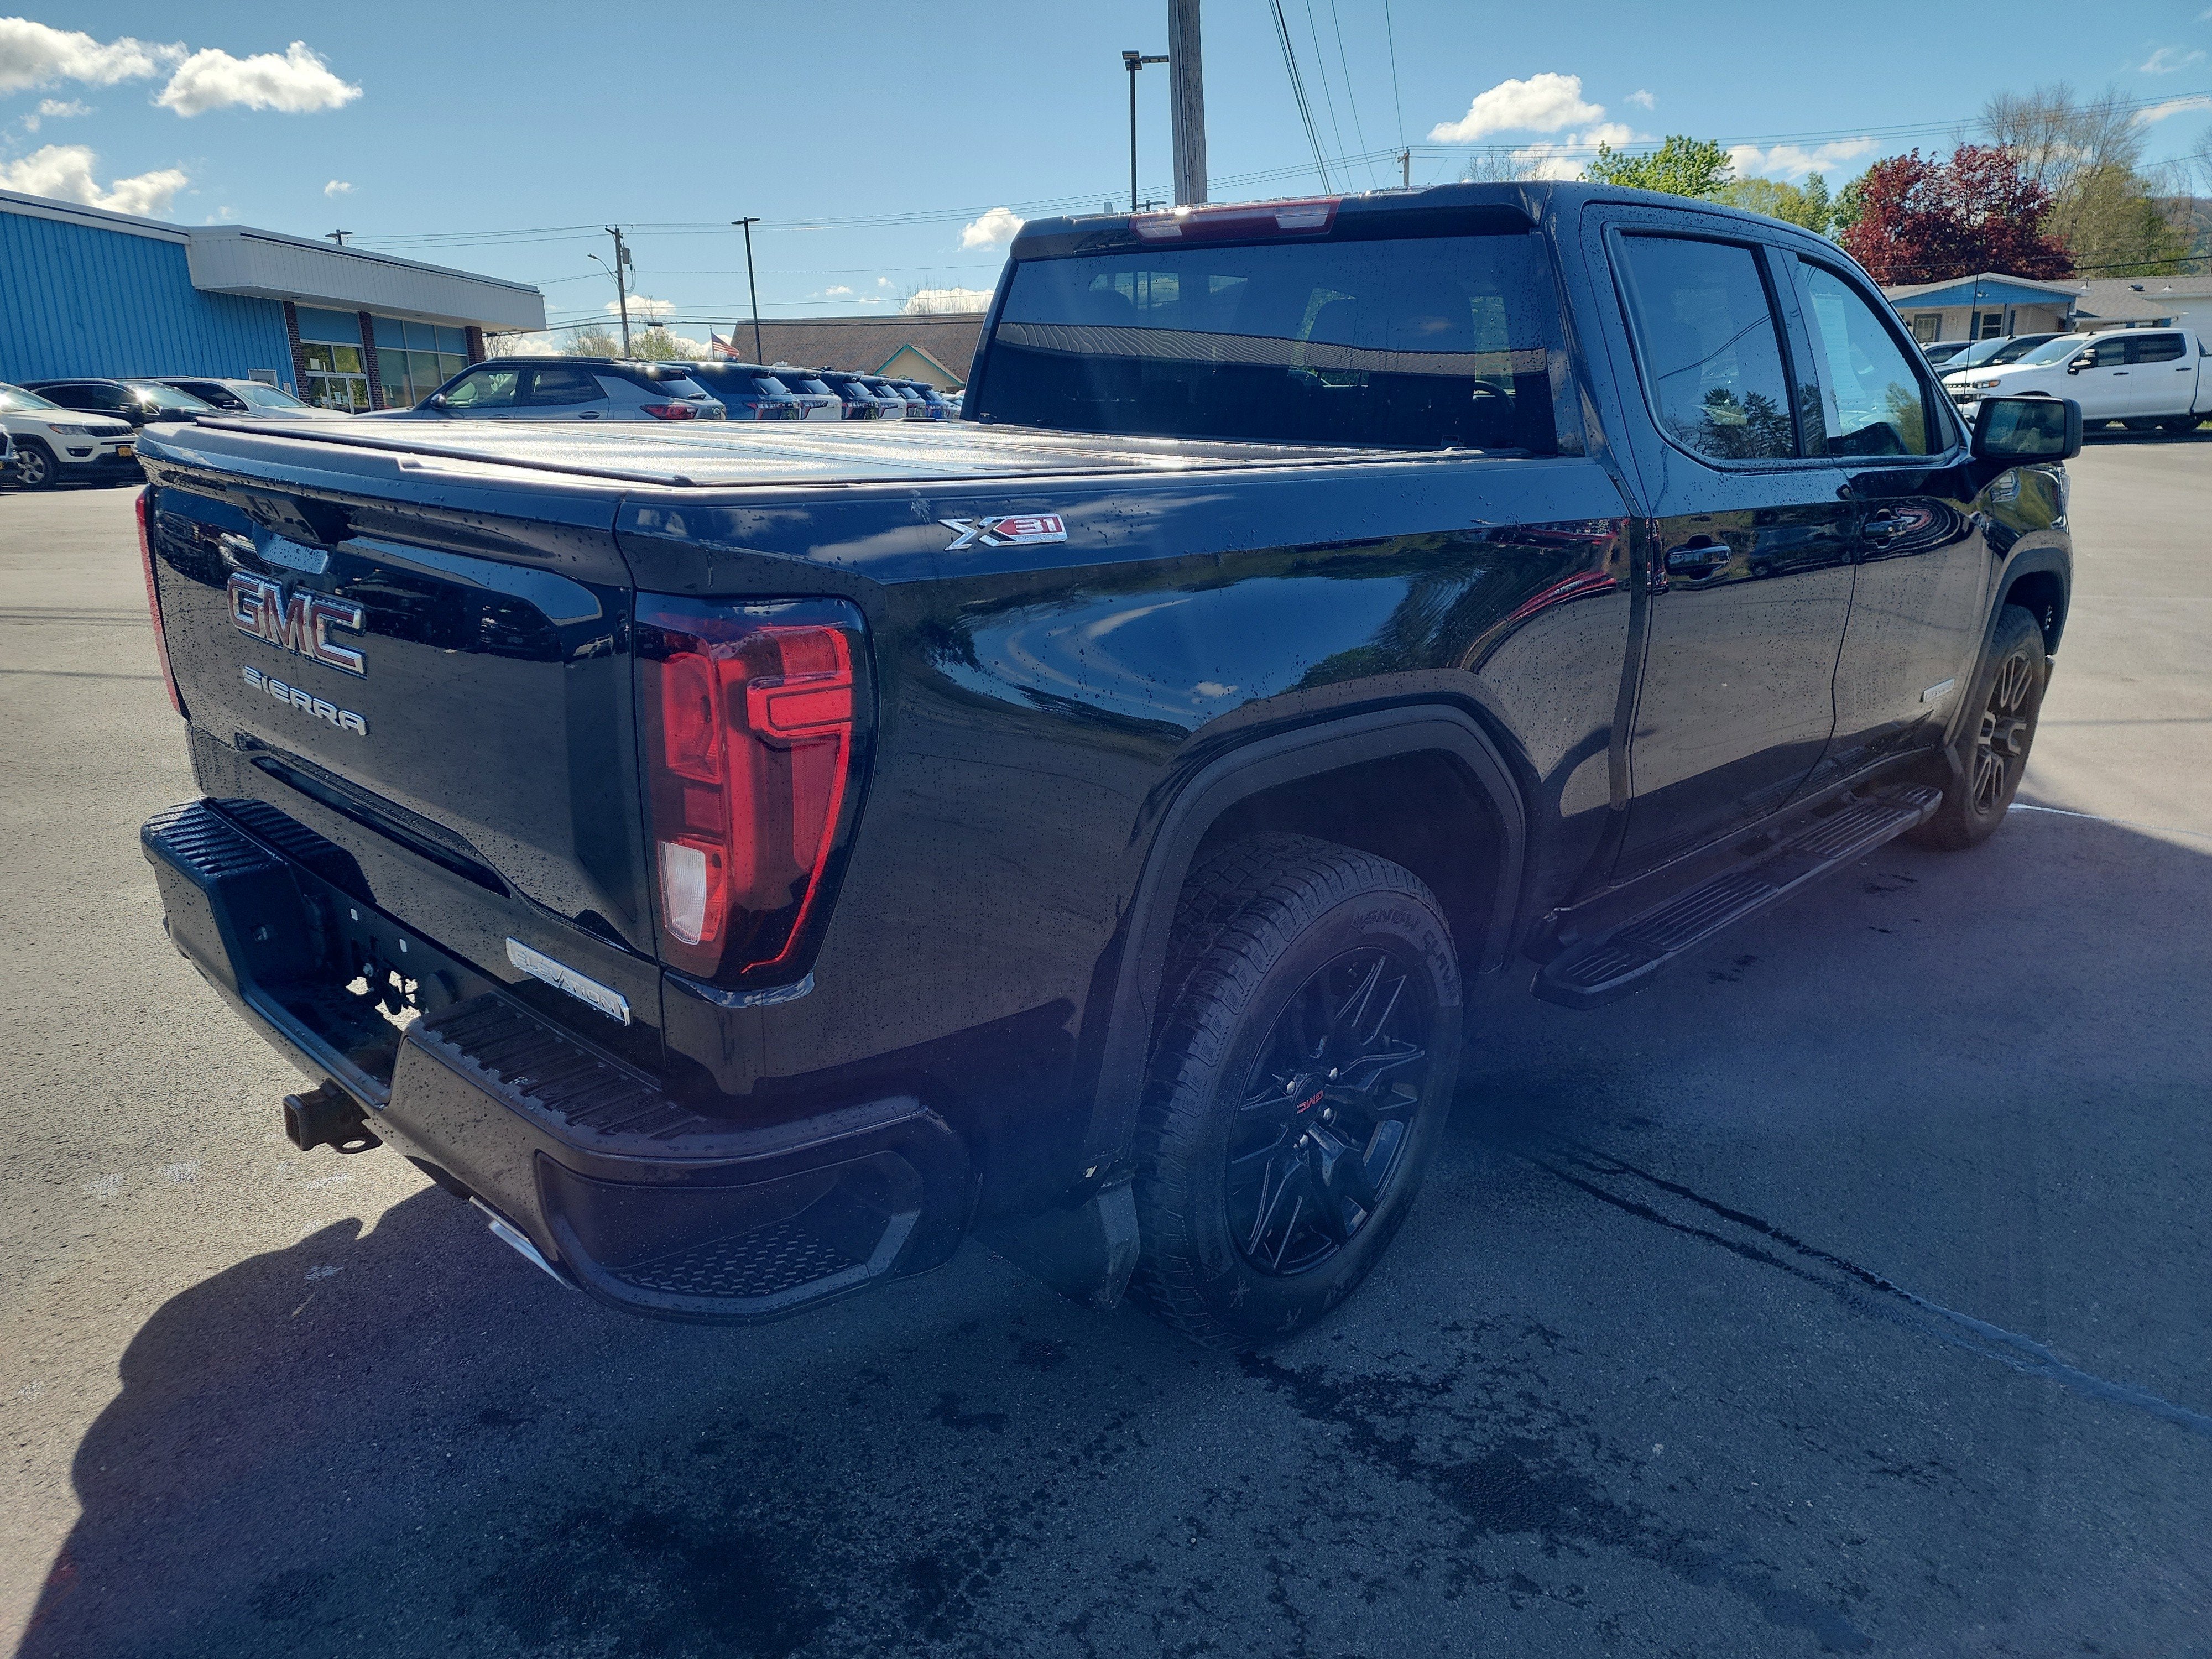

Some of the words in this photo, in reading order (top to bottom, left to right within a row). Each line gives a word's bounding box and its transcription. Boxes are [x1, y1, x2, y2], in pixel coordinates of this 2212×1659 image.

[227, 572, 368, 680] GMC
[242, 665, 368, 736] SIERRA
[1365, 909, 1421, 931] SNOW
[515, 950, 624, 1019] ELEVATION
[1296, 1089, 1324, 1114] GMC
